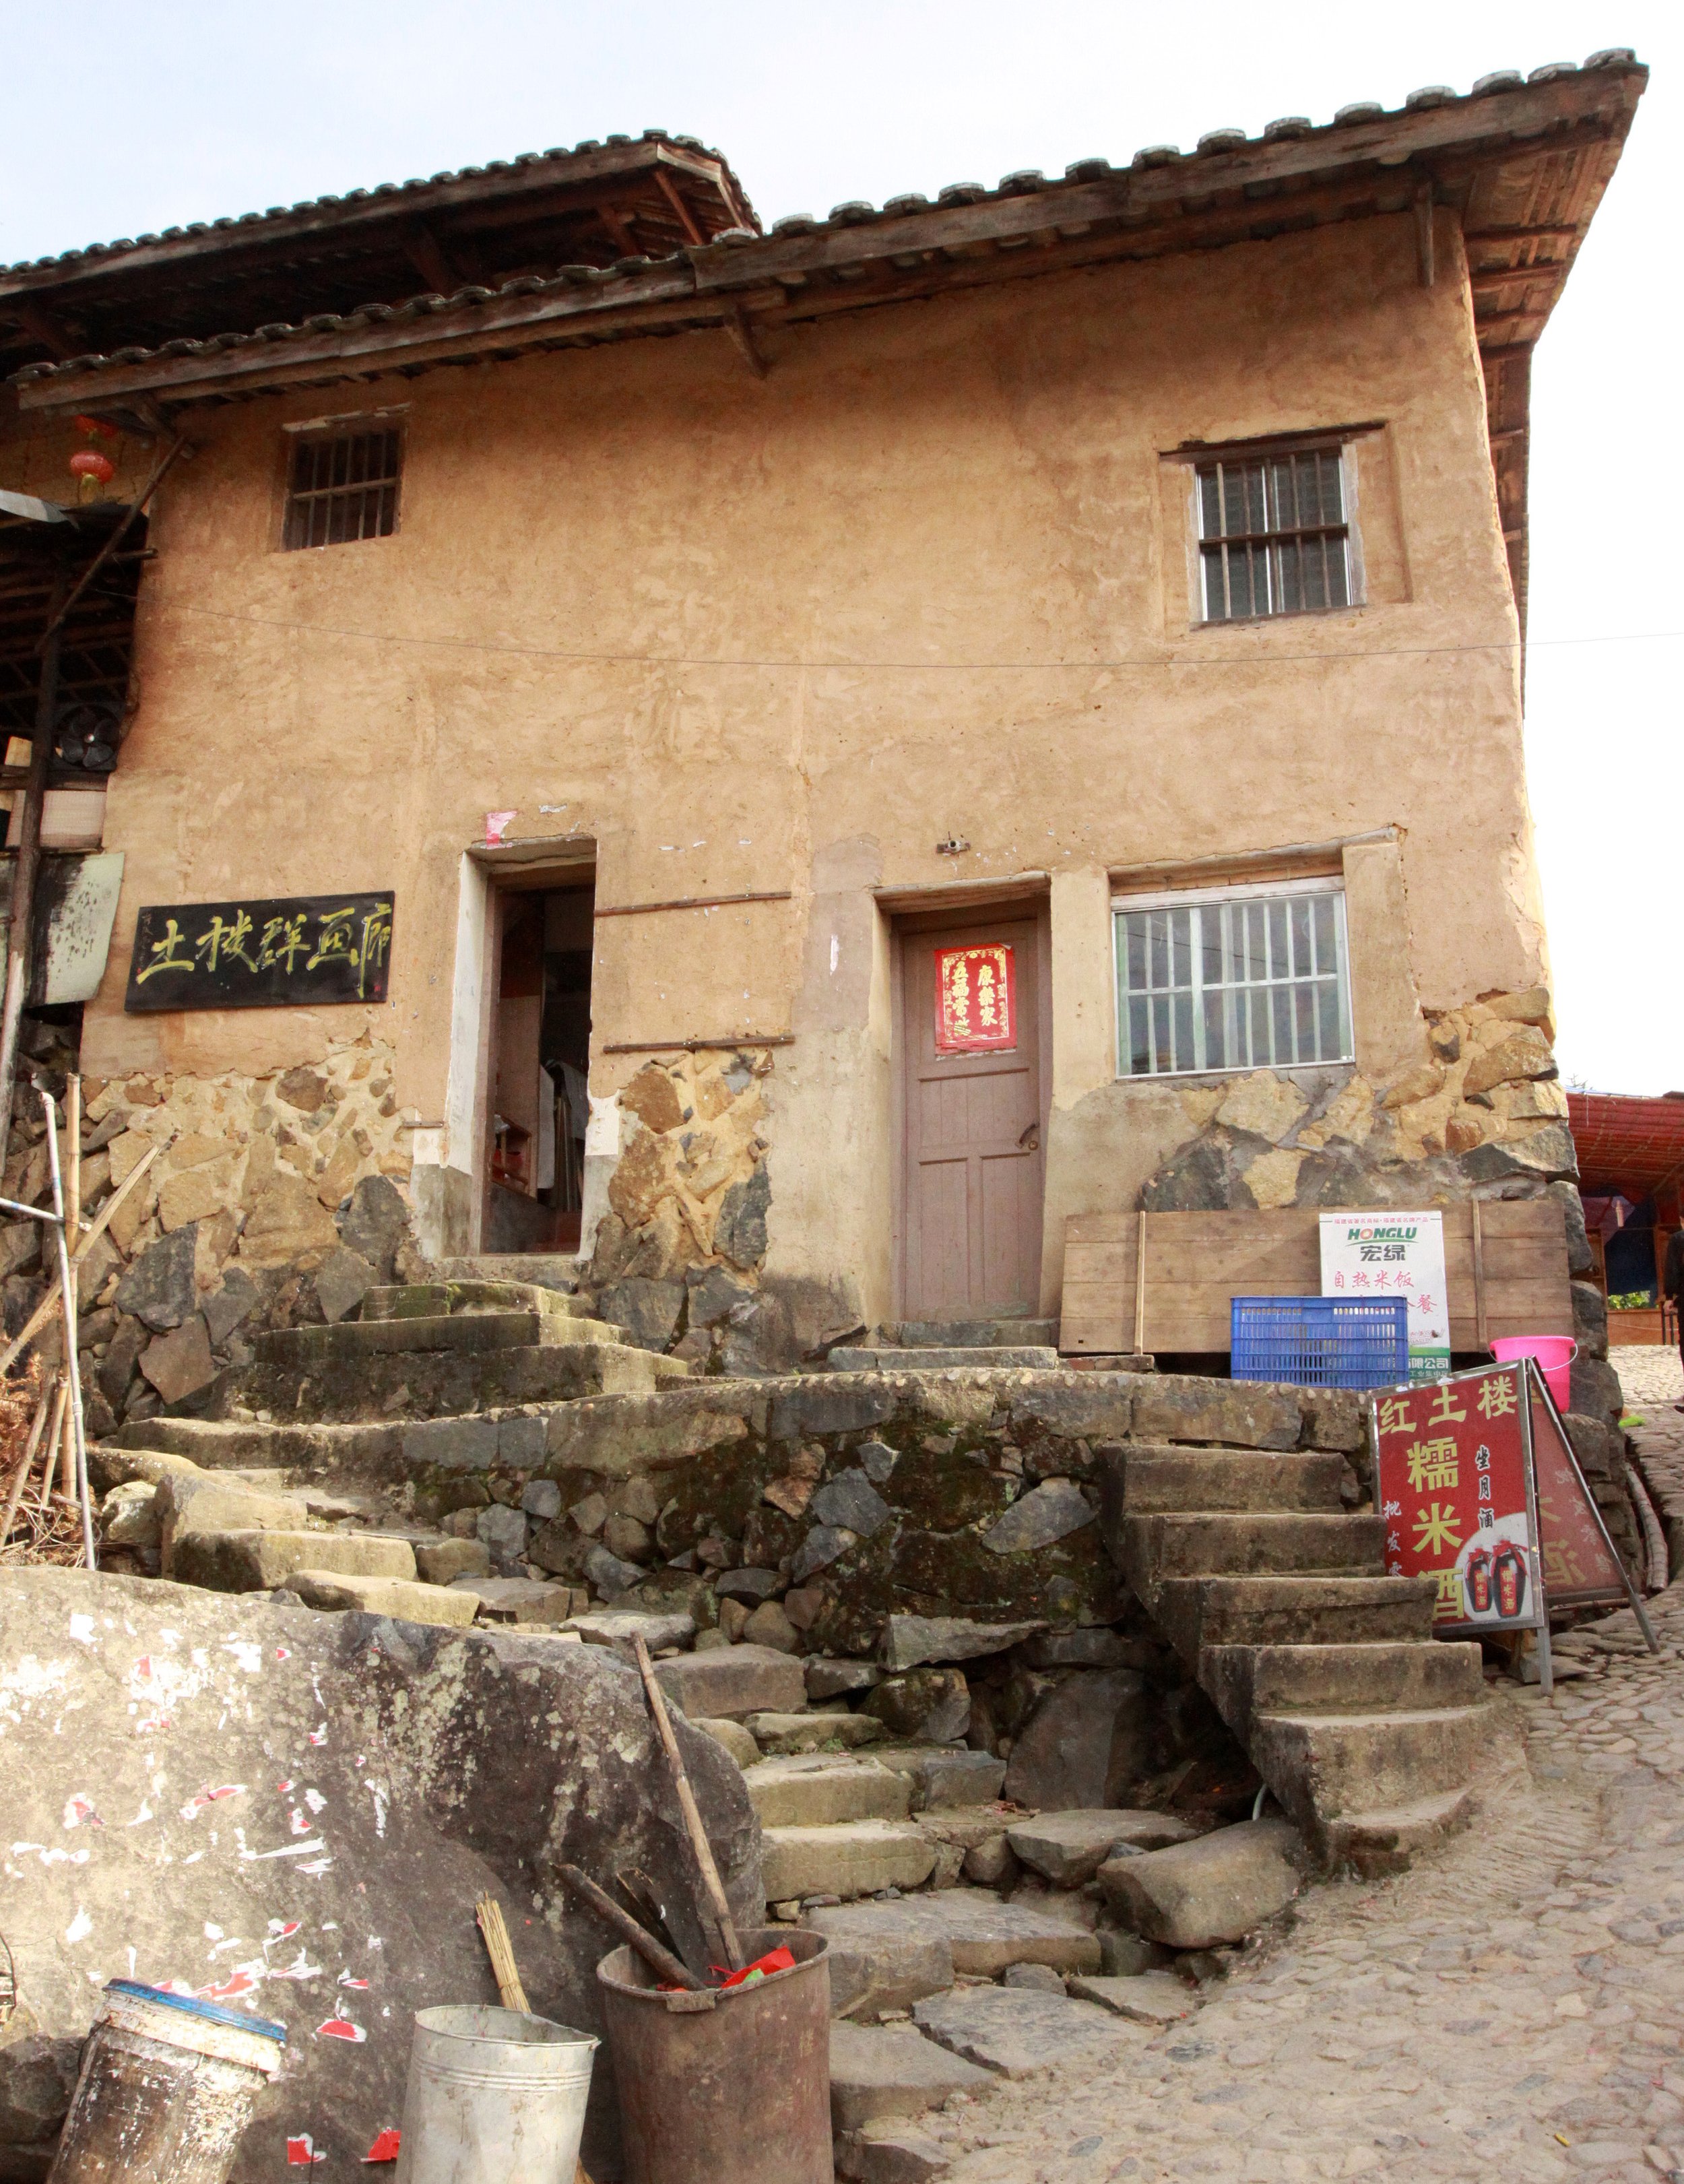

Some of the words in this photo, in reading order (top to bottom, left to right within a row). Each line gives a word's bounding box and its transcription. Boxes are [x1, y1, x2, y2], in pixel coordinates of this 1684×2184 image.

[135, 903, 391, 999] 土楼群画廊
[1347, 1227, 1417, 1240] HONGLU
[1360, 1244, 1406, 1261] 宏绿
[1334, 1270, 1415, 1290] 自热米饭
[1379, 1375, 1518, 1436] 红土楼
[1406, 1436, 1464, 1621] 糯米酒
